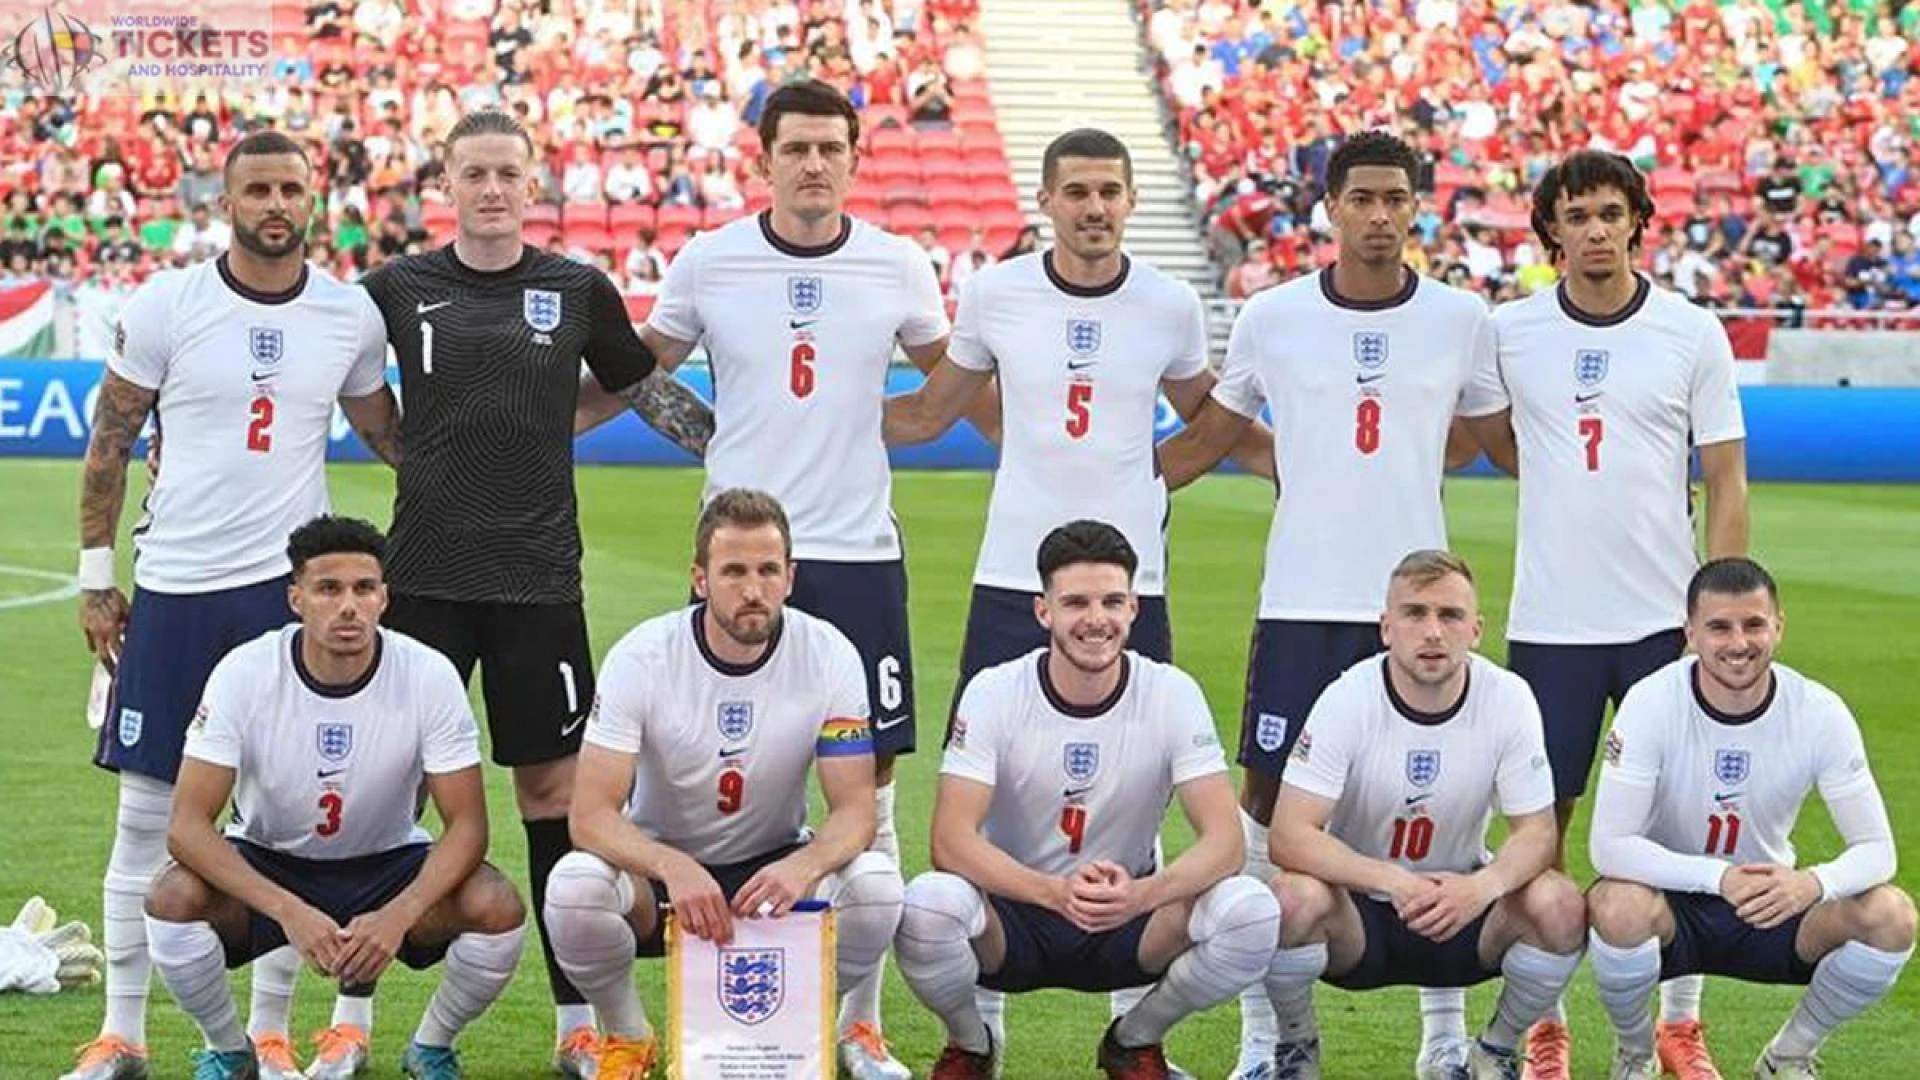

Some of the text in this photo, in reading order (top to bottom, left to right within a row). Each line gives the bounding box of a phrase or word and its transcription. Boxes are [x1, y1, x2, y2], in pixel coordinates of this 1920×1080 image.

[420, 320, 433, 374] 1
[790, 343, 816, 398] 6
[247, 396, 274, 453] 2
[1066, 383, 1092, 439] 5
[1355, 398, 1381, 454] 8
[1578, 417, 1603, 471] 7
[559, 661, 578, 713] 1
[878, 655, 902, 711] 6
[316, 792, 343, 836] 3
[717, 770, 744, 815] 9
[1060, 806, 1086, 855] 4
[1389, 817, 1434, 862] 10
[1704, 814, 1741, 856] 11
